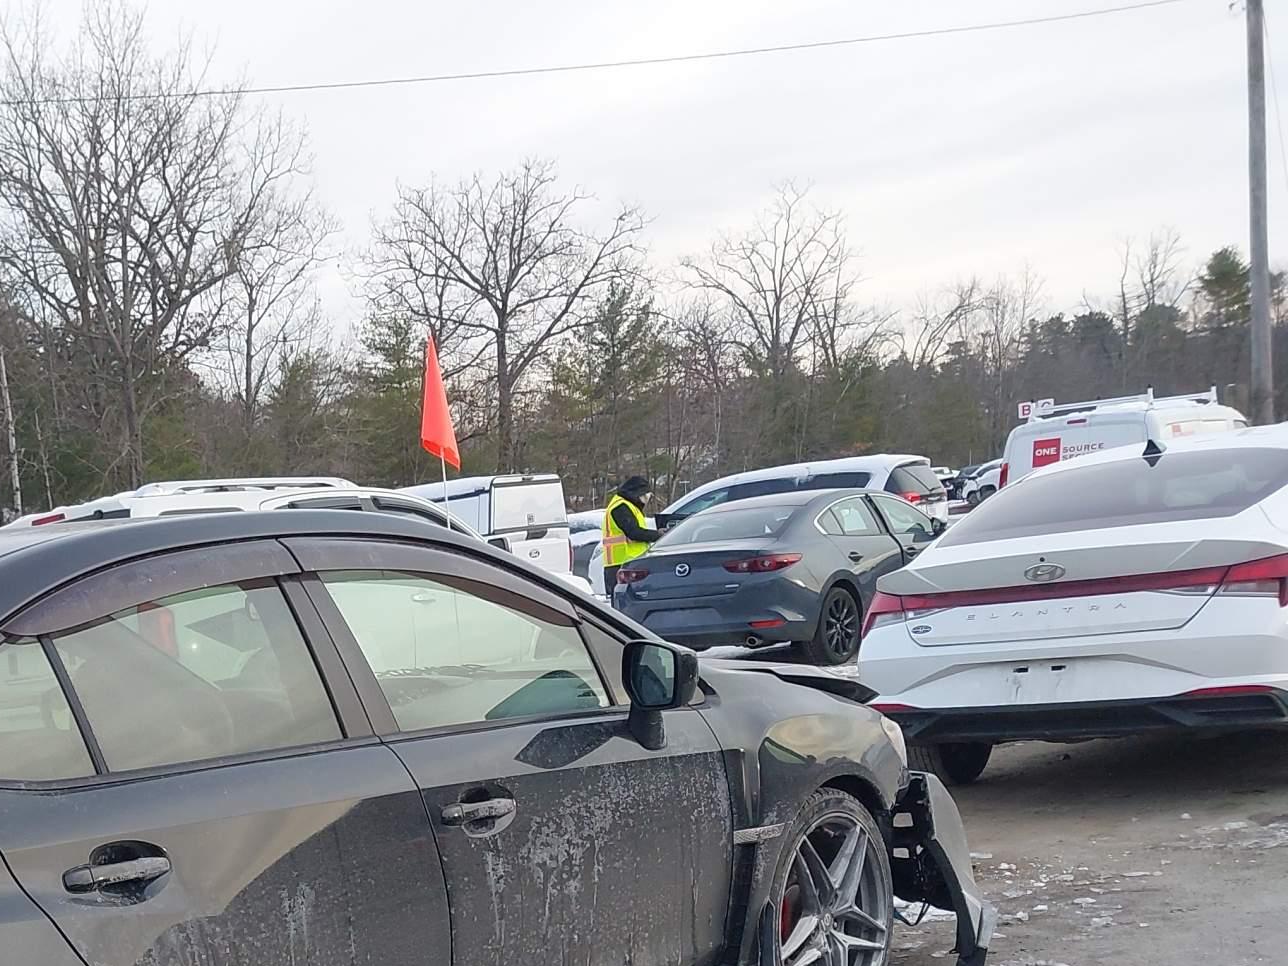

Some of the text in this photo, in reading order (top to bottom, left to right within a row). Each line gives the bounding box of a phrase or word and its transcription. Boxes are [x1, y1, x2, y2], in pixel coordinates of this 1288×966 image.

[1021, 404, 1031, 416] B
[1035, 447, 1057, 456] ONE
[1062, 442, 1105, 454] SOURCE
[967, 602, 1127, 621] ELANTRA
